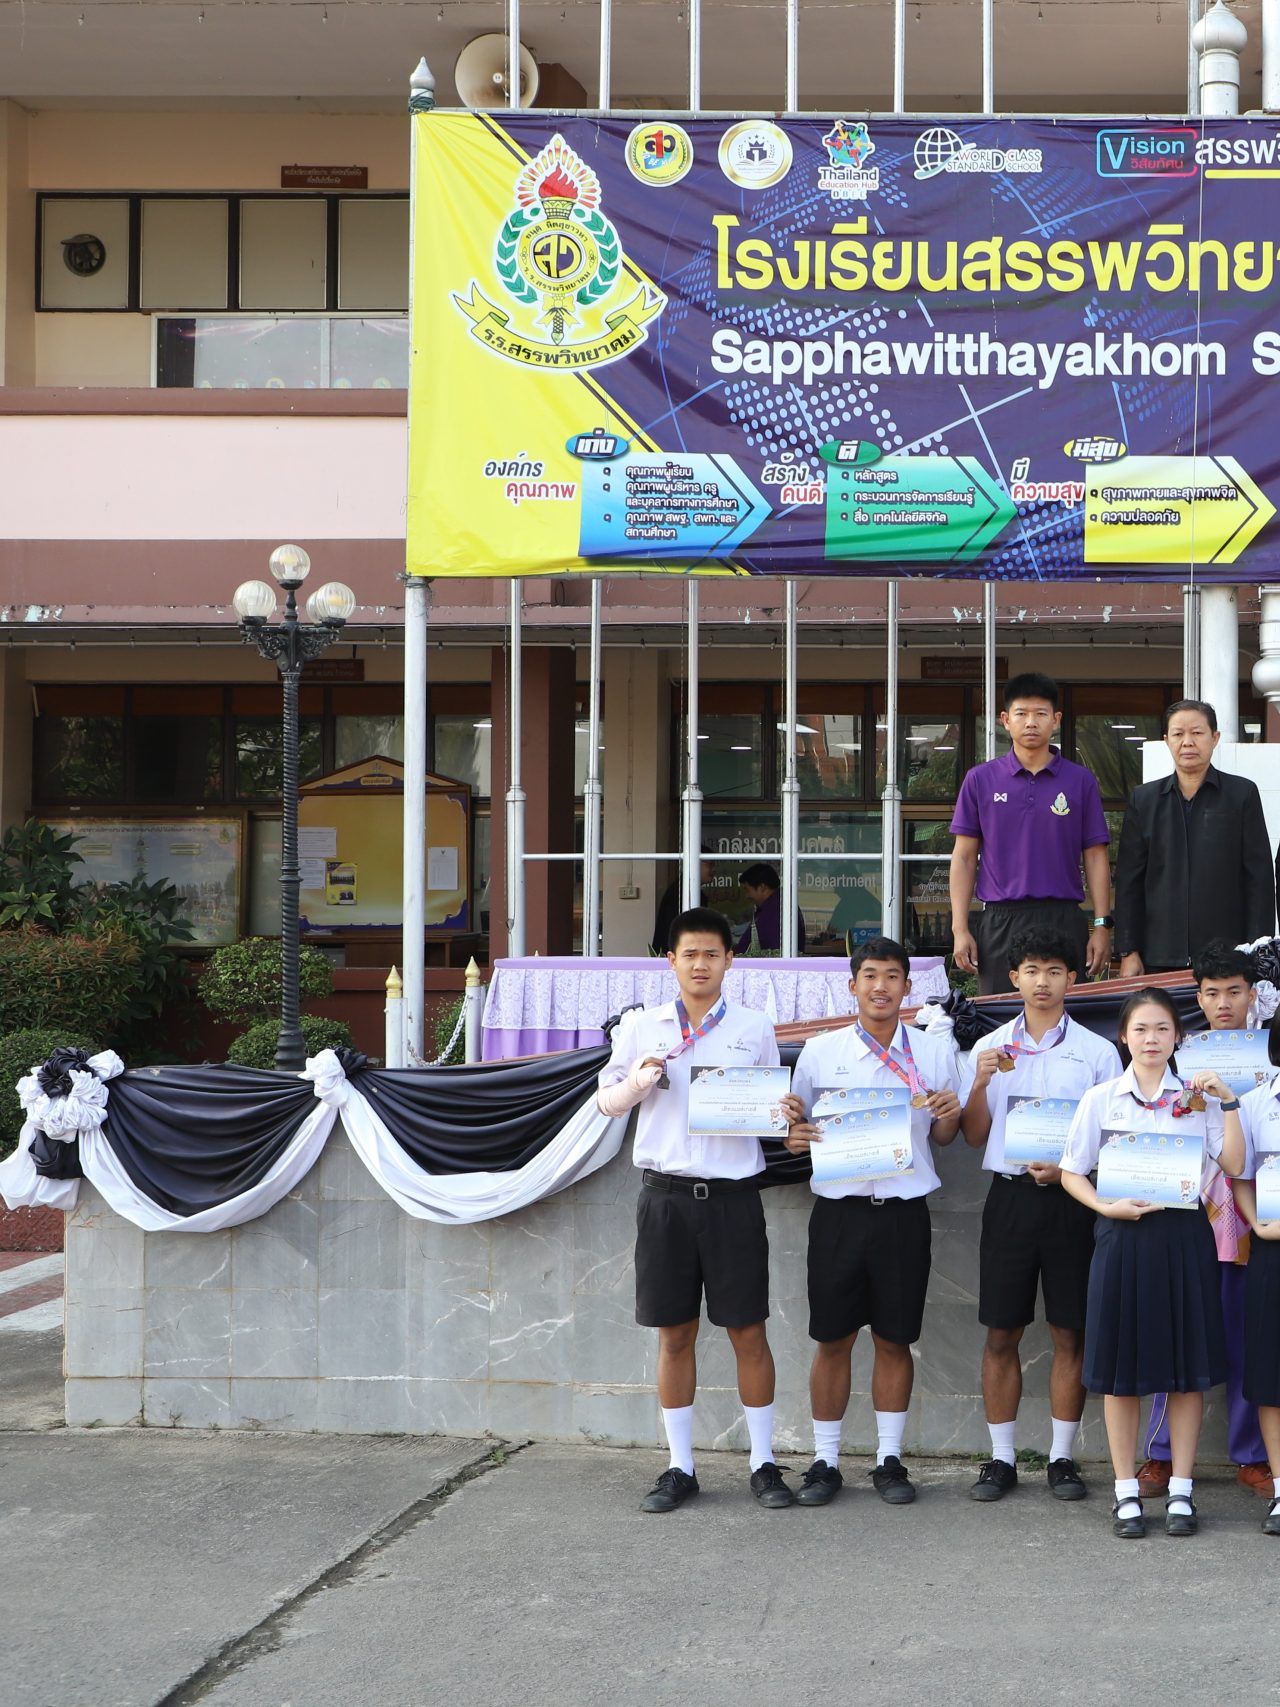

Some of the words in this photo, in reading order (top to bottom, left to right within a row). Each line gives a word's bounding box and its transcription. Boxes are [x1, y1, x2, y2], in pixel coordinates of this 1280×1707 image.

[1104, 136, 1185, 169] Vision
[820, 168, 878, 181] Thailand
[820, 181, 859, 189] Education
[861, 181, 878, 189] Hub
[711, 331, 1226, 388] Sapphawitthayakhom
[577, 428, 617, 455] เก่ง
[837, 440, 859, 461] ดี
[1073, 438, 1119, 462] มีสุข
[484, 451, 543, 478] องค์กร
[625, 462, 693, 481] คุณภาพผู้เรียน
[762, 453, 808, 483] สร้าง
[1012, 460, 1028, 481] มี
[854, 468, 898, 485] หลักสูตร
[506, 481, 576, 504] คุณภาพ
[782, 480, 823, 503] คนดี
[854, 487, 975, 506] กระบวนการจัดการเรียนรู้
[1012, 480, 1085, 506] ความสุข
[1102, 485, 1238, 504] สุขภาพกายและสุขภาพจิต
[625, 512, 664, 525] คุณภาพ
[854, 507, 868, 523] สื่อ
[1102, 509, 1179, 524] ความปลอดภัย
[805, 872, 876, 890] Department
